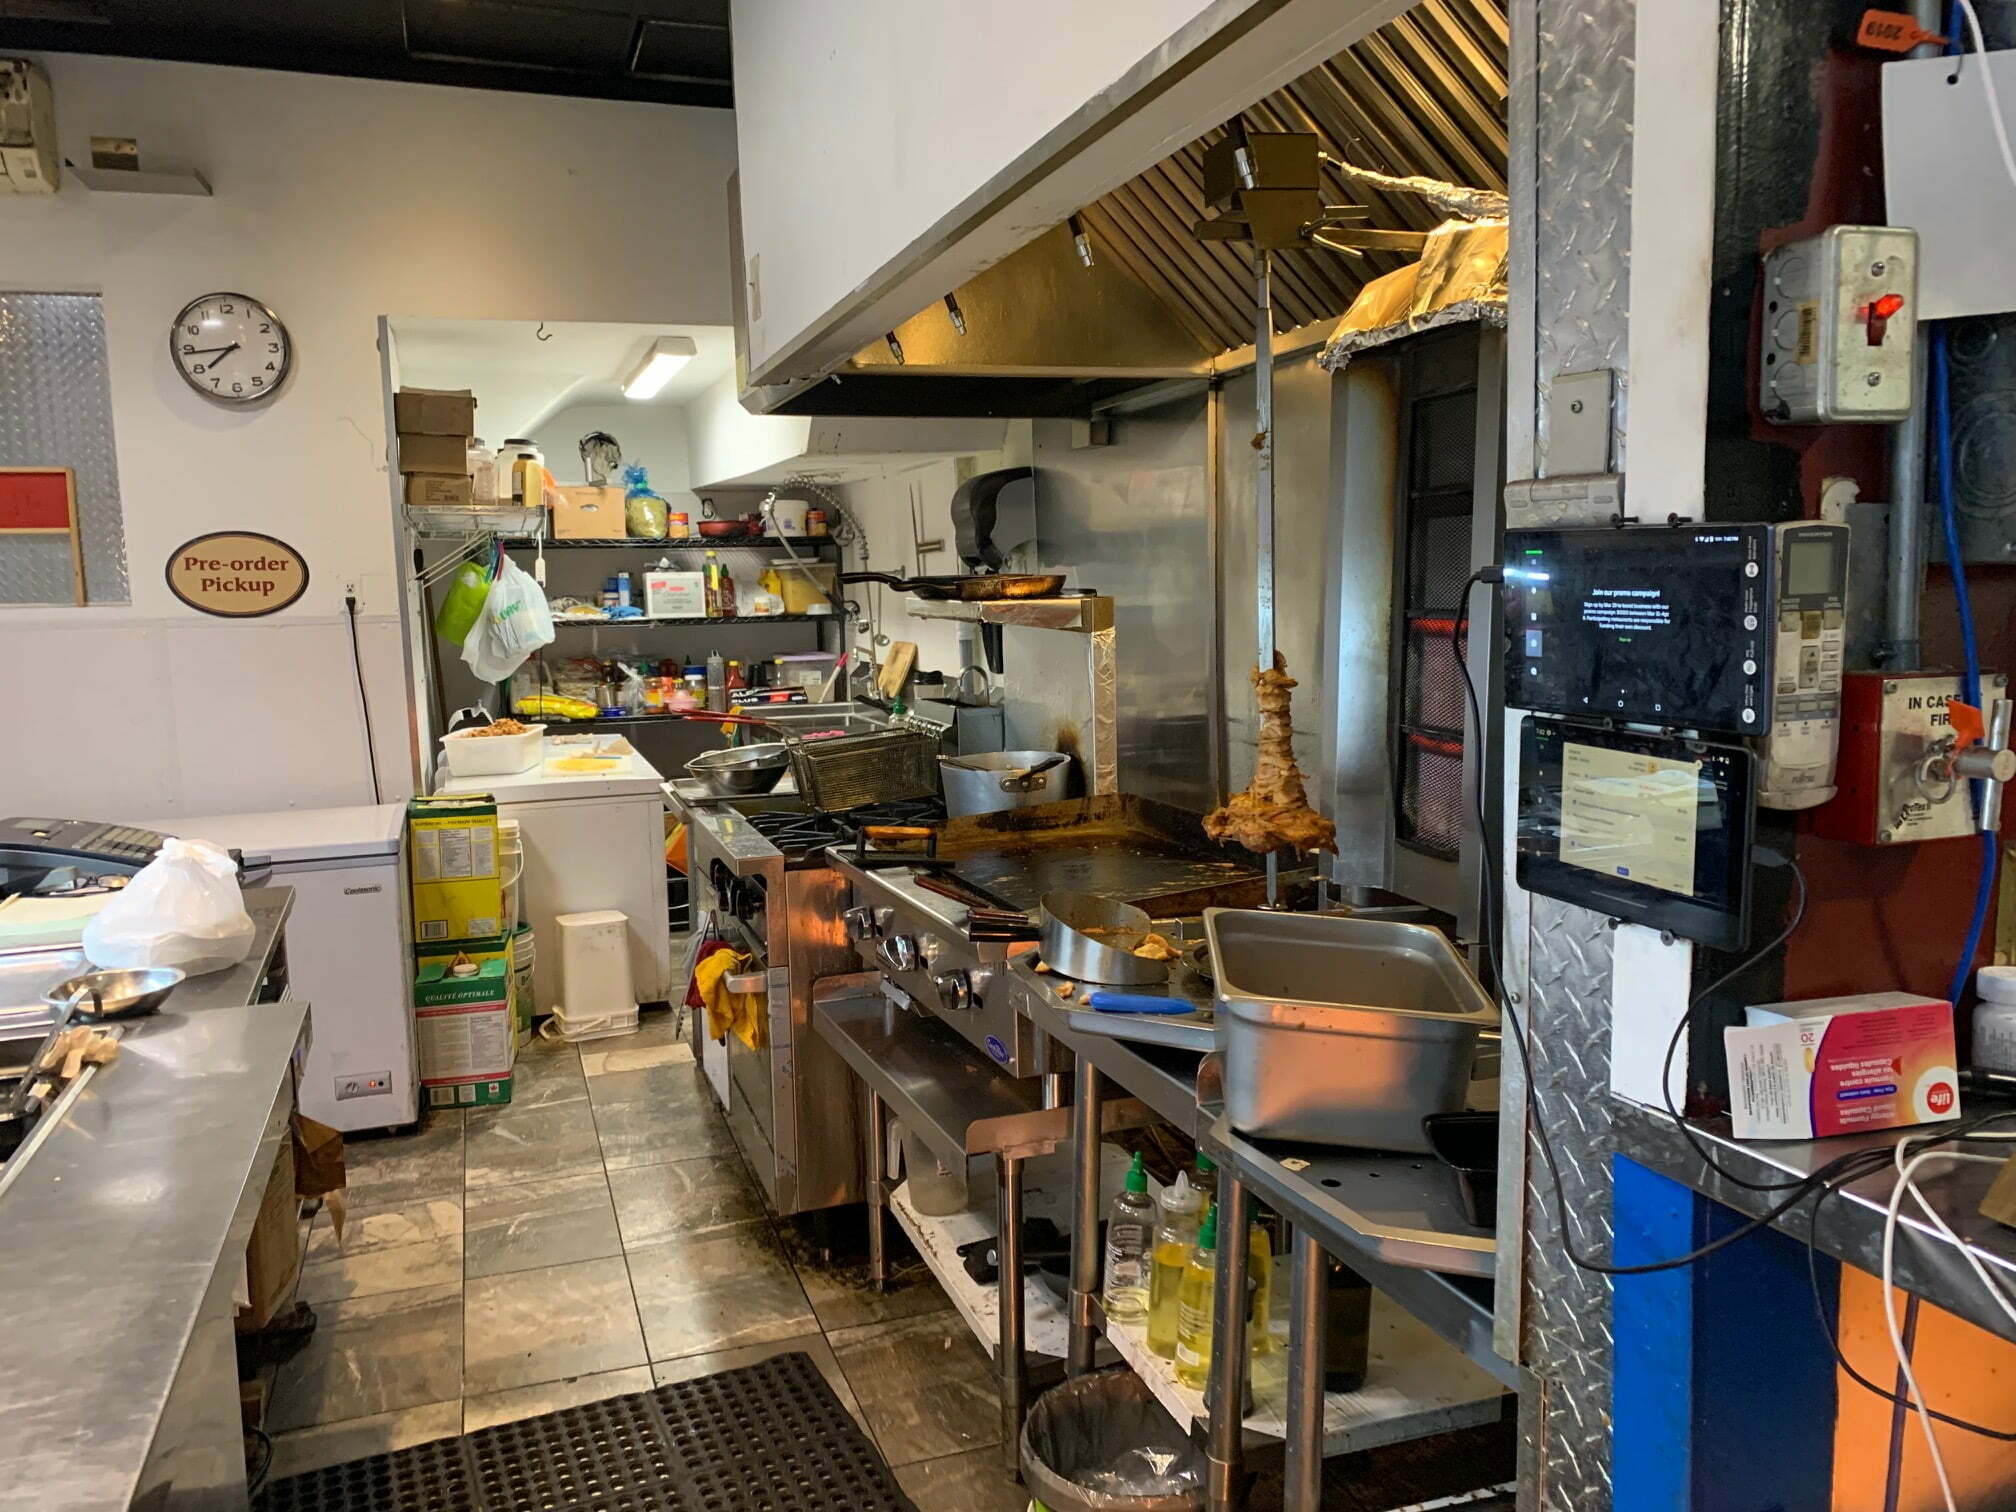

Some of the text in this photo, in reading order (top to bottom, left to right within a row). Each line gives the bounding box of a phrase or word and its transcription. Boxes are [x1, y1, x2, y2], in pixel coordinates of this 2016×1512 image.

[220, 305, 234, 314] 12
[201, 311, 209, 320] 11
[187, 325, 199, 335] 10
[260, 323, 270, 333] 2
[268, 343, 279, 353] 3
[193, 364, 205, 374] 8
[265, 362, 275, 371] 4
[210, 378, 220, 388] 7
[251, 376, 263, 386] 5
[232, 383, 242, 392] 6
[184, 556, 289, 571] Pre-order
[201, 577, 275, 597] Pickup
[1908, 694, 1962, 710] IN CASE
[1931, 712, 1952, 726] FIR
[1930, 1092, 1951, 1106] Life
